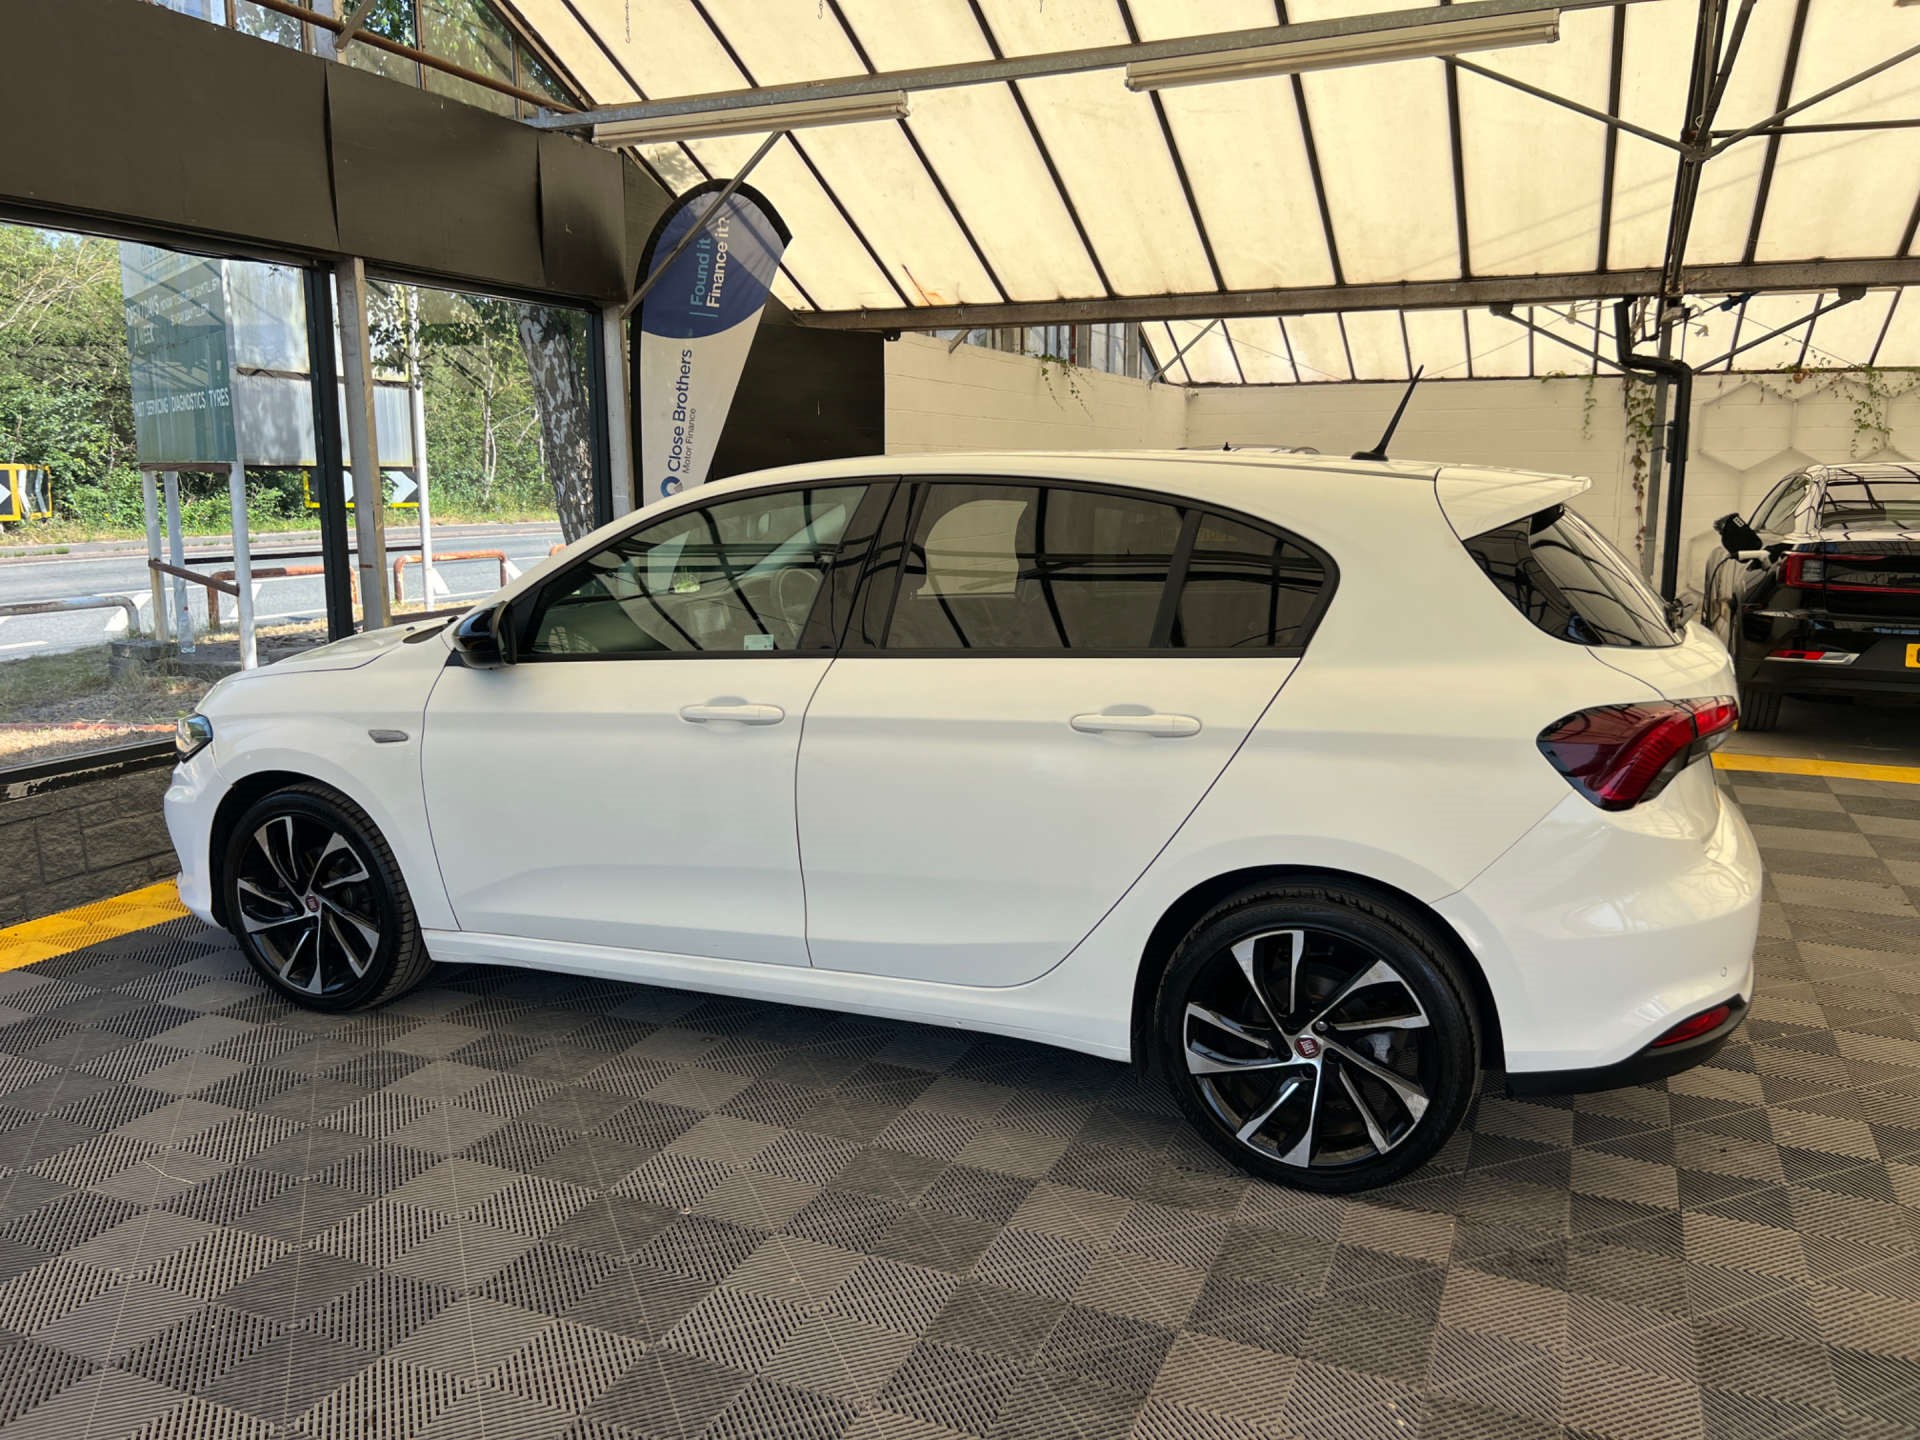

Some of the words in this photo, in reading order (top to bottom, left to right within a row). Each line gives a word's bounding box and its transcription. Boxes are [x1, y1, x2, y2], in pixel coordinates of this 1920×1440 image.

[697, 238, 711, 250] it
[715, 216, 730, 238] it?
[690, 253, 711, 305] Found
[706, 241, 728, 308] Finance
[171, 391, 206, 413] DIAGNOSTICS
[208, 387, 230, 408] TYRES
[672, 348, 693, 422] Brothers
[686, 408, 697, 445] Finance
[667, 426, 684, 472] Close
[683, 446, 692, 474] Motor
